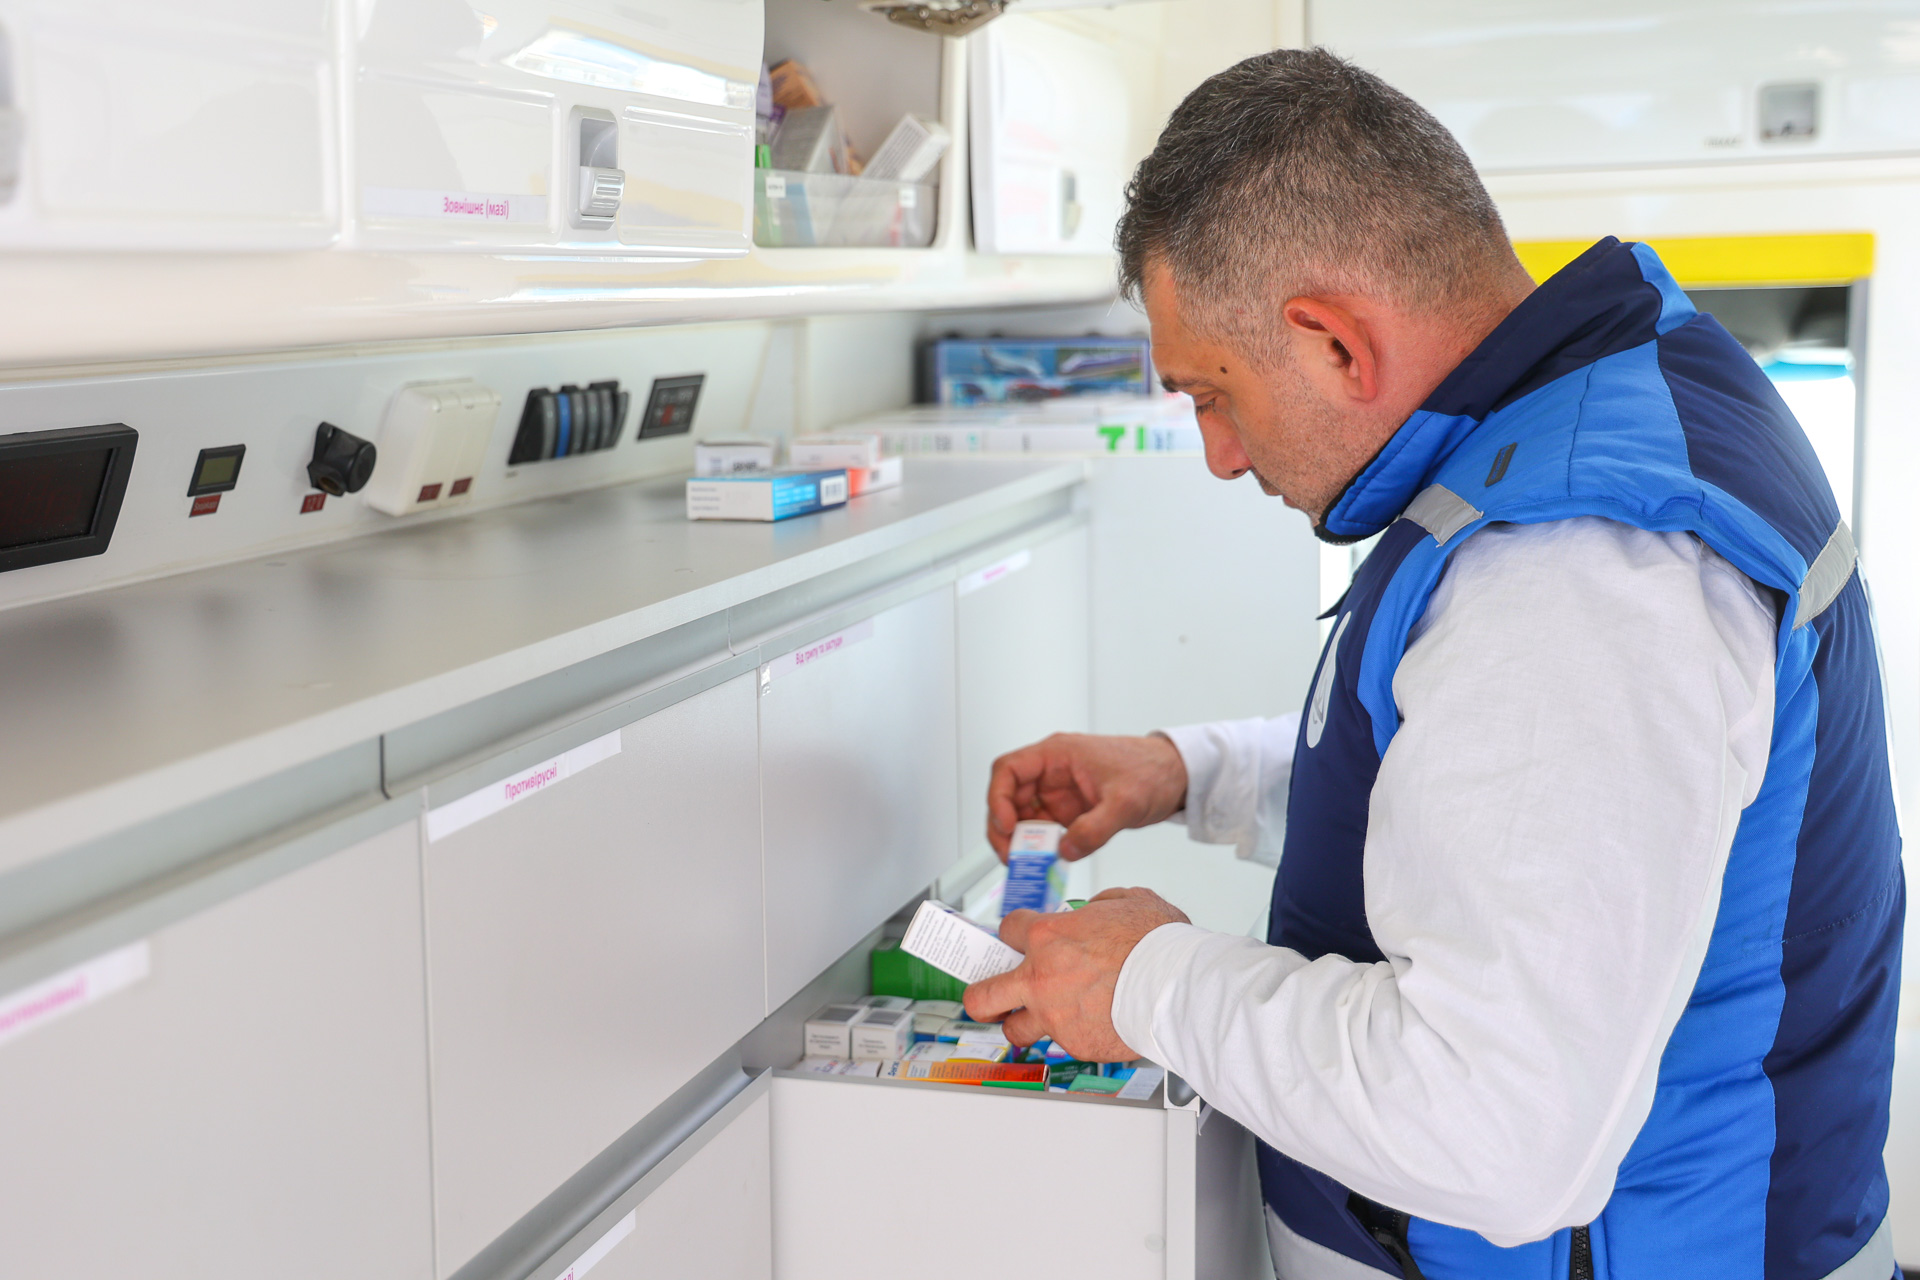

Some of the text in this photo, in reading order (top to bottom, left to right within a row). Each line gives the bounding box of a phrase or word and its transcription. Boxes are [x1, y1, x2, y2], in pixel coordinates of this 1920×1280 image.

[443, 196, 510, 220] Зовнішнє (мазі)
[505, 762, 558, 800] Противірусні
